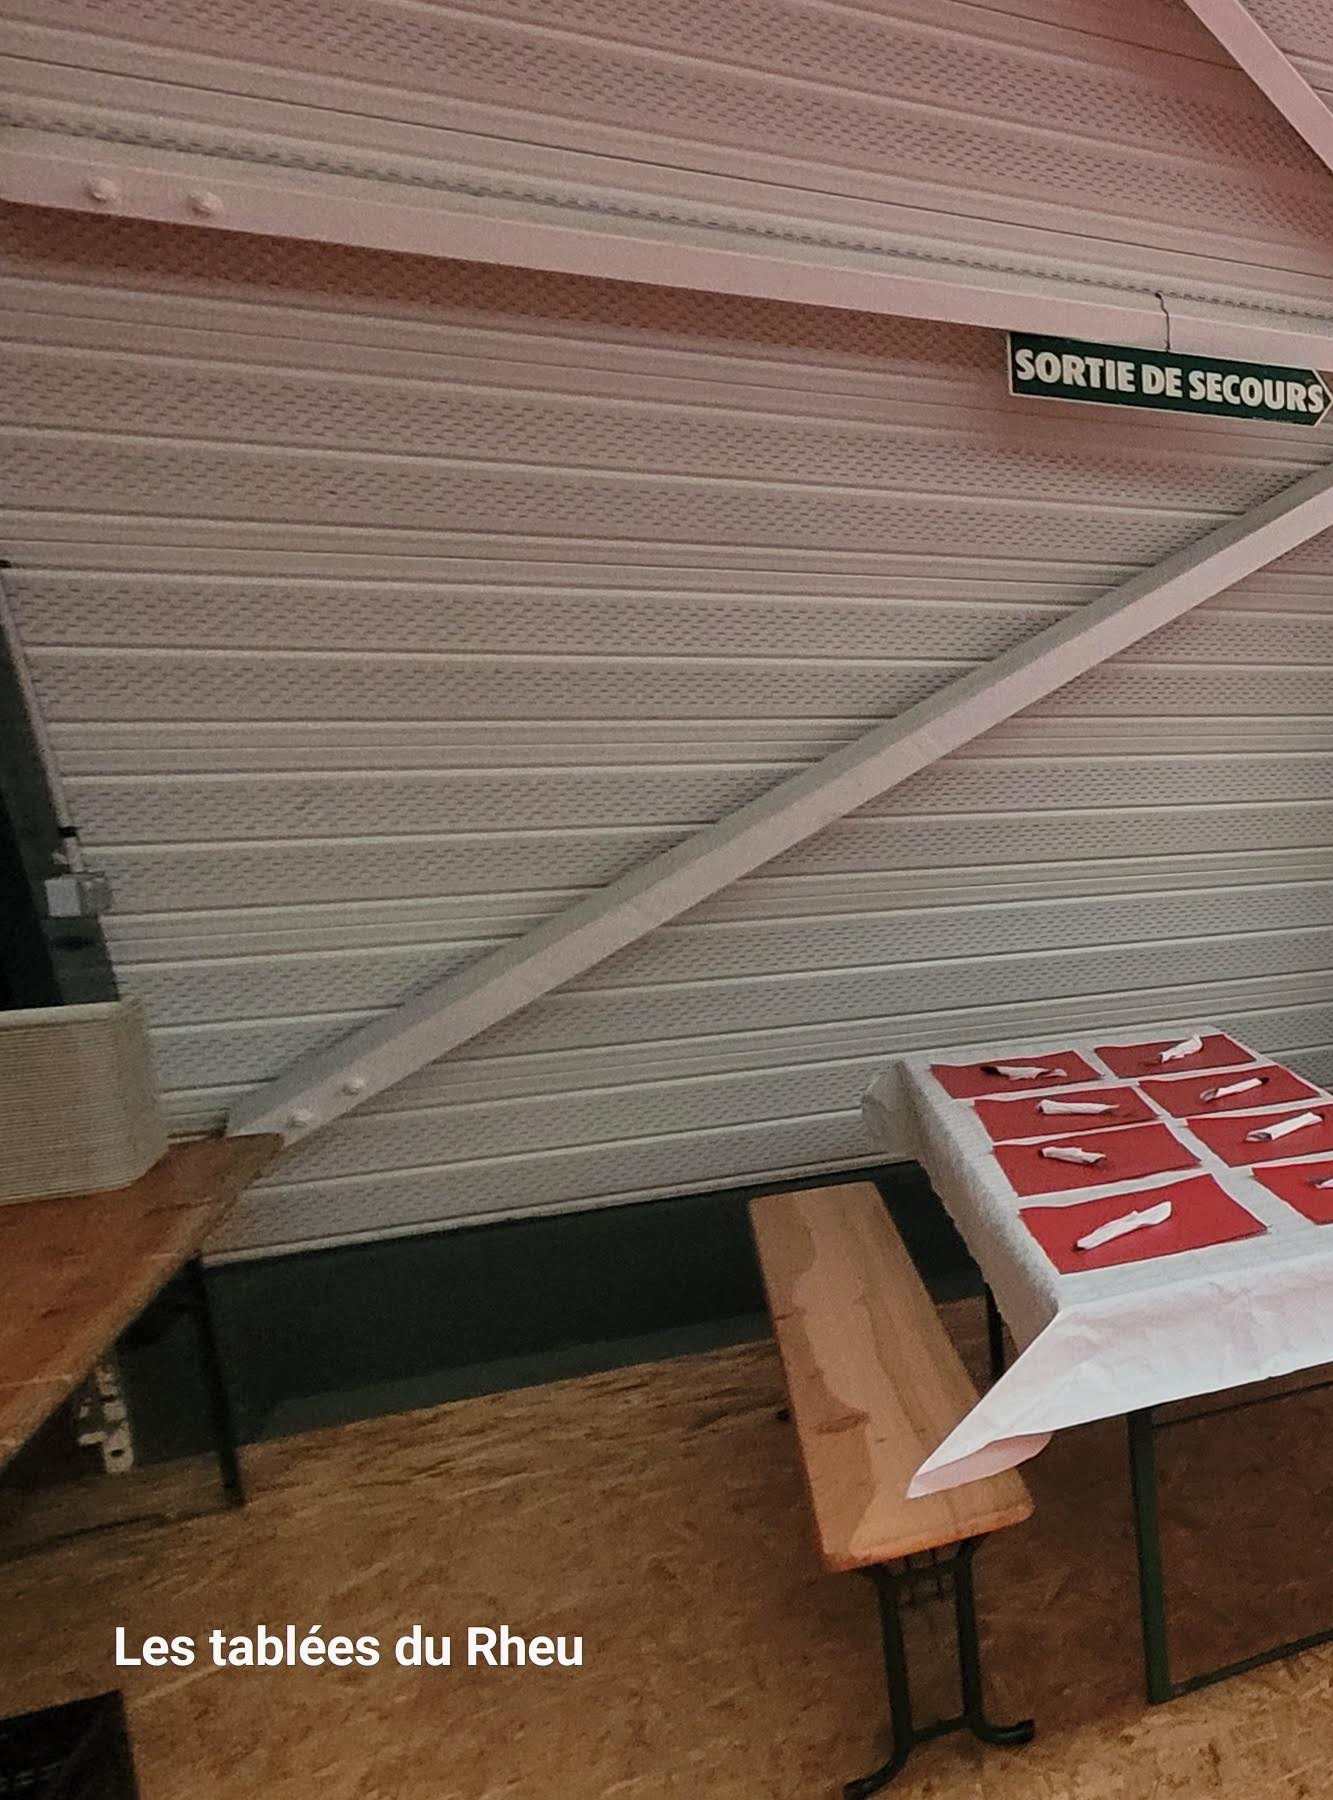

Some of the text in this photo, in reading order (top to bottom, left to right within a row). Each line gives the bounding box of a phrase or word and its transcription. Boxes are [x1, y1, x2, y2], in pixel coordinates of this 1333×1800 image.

[1015, 349, 1325, 414] SORTIE DE SECOURS
